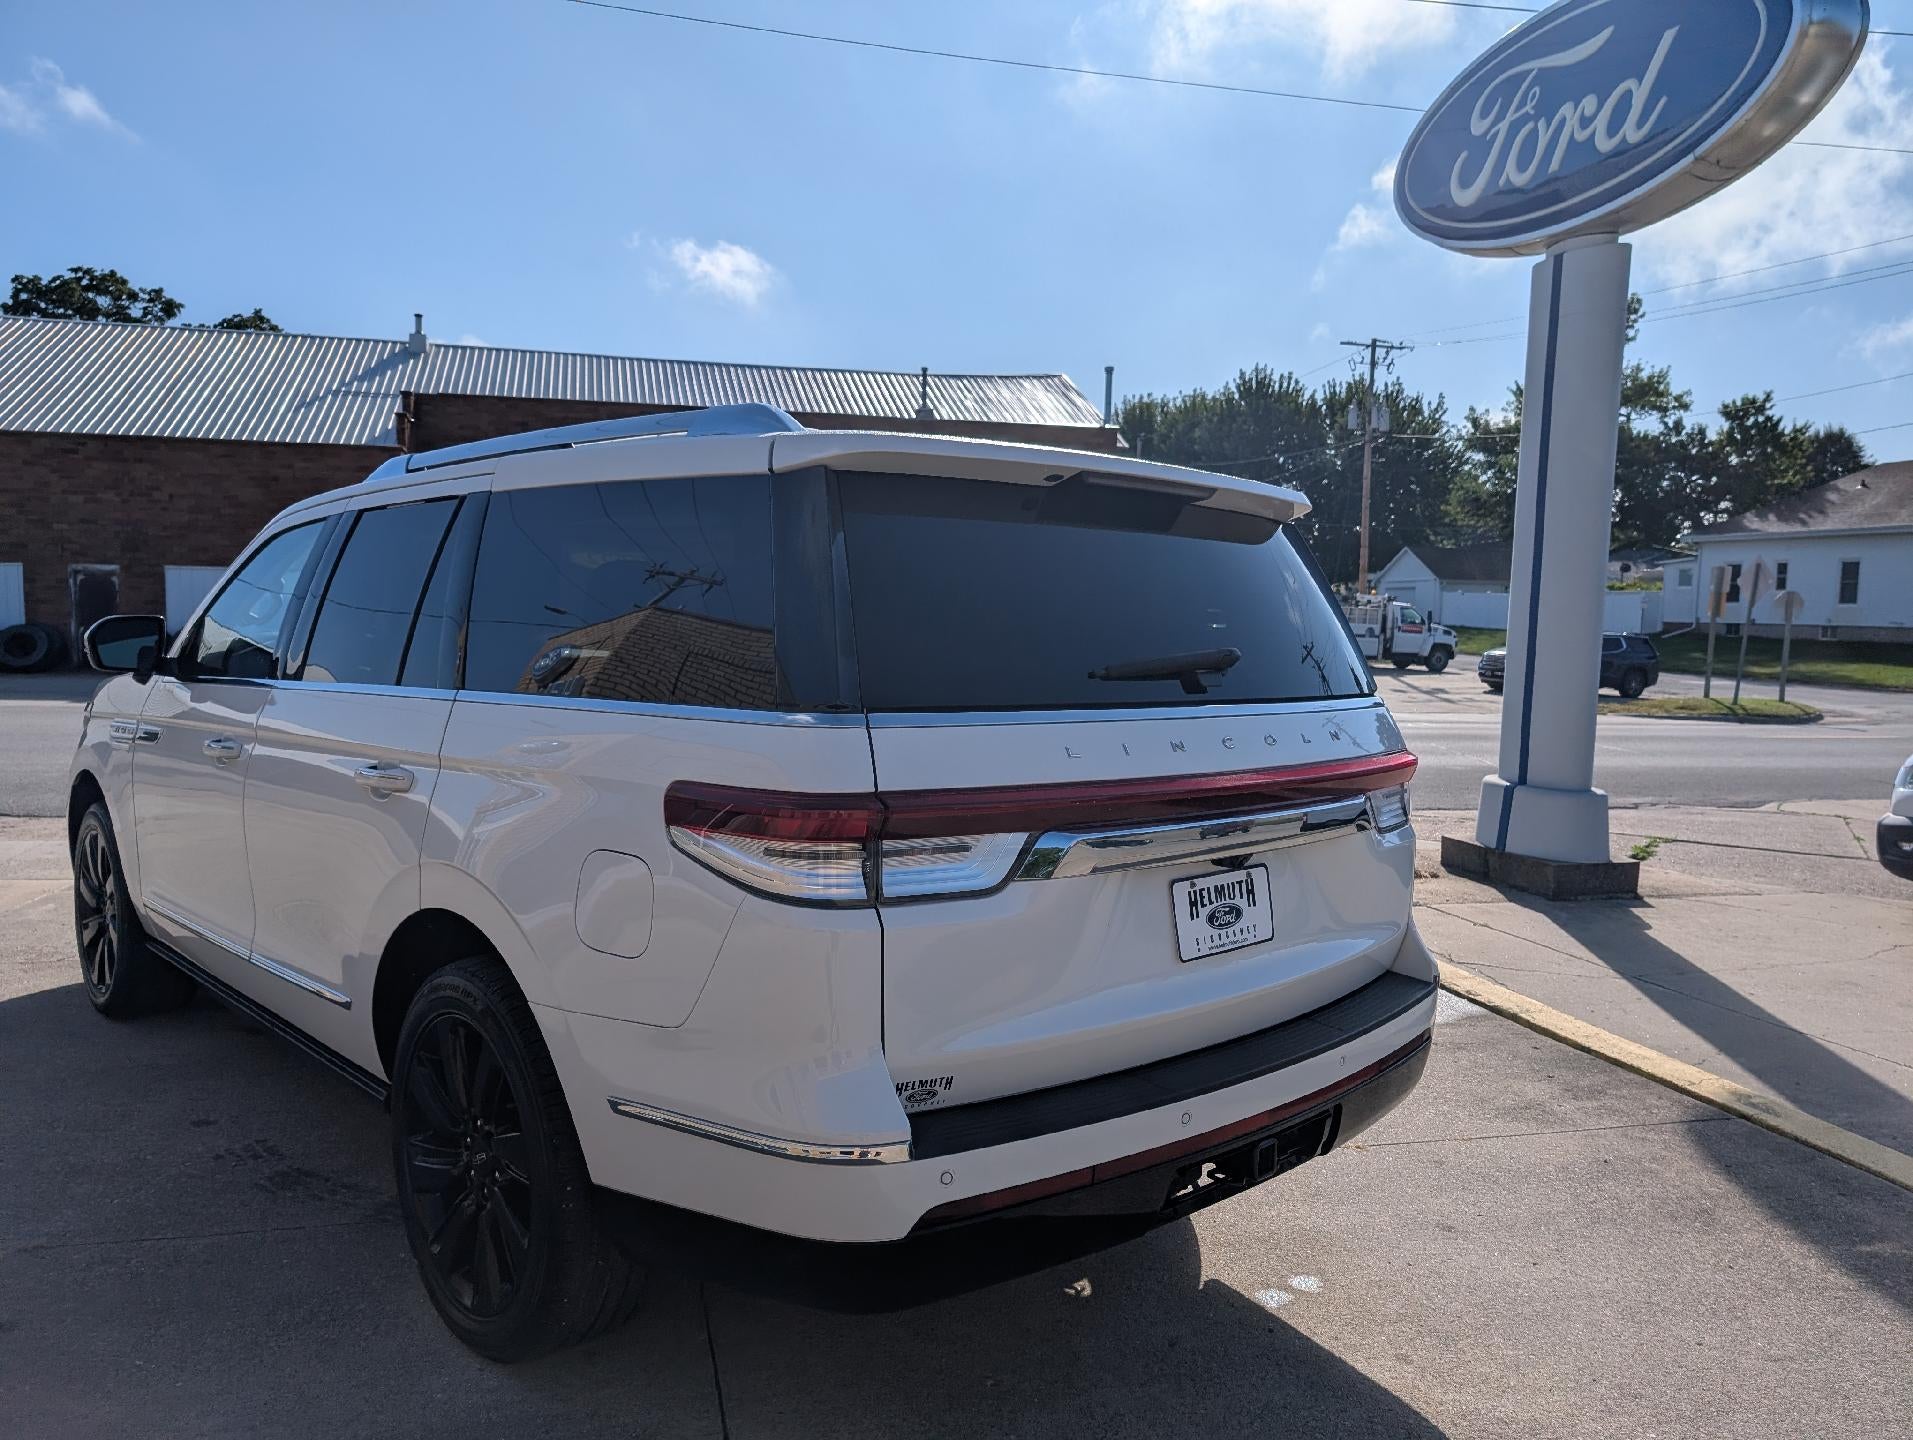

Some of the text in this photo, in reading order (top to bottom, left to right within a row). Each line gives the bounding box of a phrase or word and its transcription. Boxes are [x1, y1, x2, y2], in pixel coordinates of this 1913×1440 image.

[1450, 25, 1680, 207] Ford
[1064, 729, 1341, 758] LINCOLN
[1187, 877, 1257, 922] HELMUTH
[1213, 906, 1236, 926] Ford
[895, 1075, 954, 1097] HELMUTH
